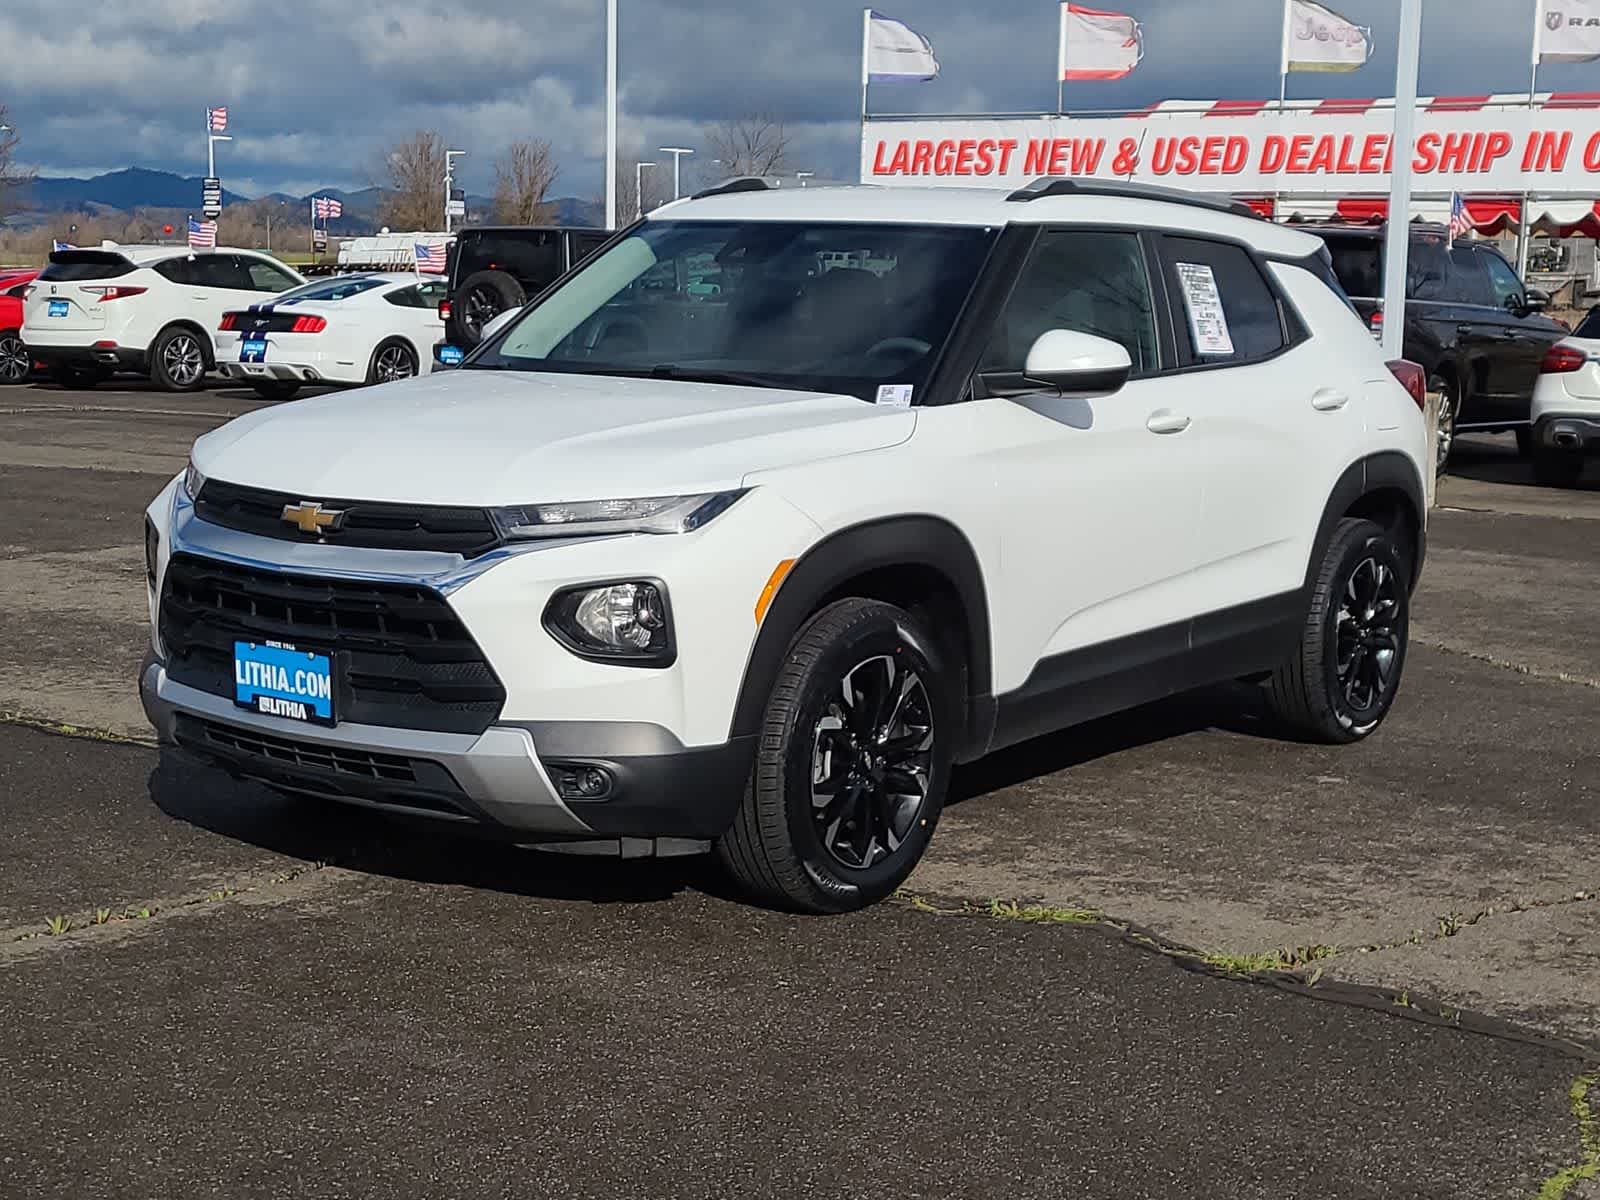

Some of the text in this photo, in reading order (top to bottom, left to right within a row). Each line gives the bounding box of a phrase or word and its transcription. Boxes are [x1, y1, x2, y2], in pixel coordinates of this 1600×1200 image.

[872, 138, 1017, 176] LARGEST
[1023, 138, 1106, 176] NEW
[1111, 137, 1141, 176] &
[1151, 135, 1249, 175] USED
[1521, 131, 1573, 173] IN
[235, 659, 331, 700] LITHIA.COM
[270, 698, 307, 720] LITHIA
